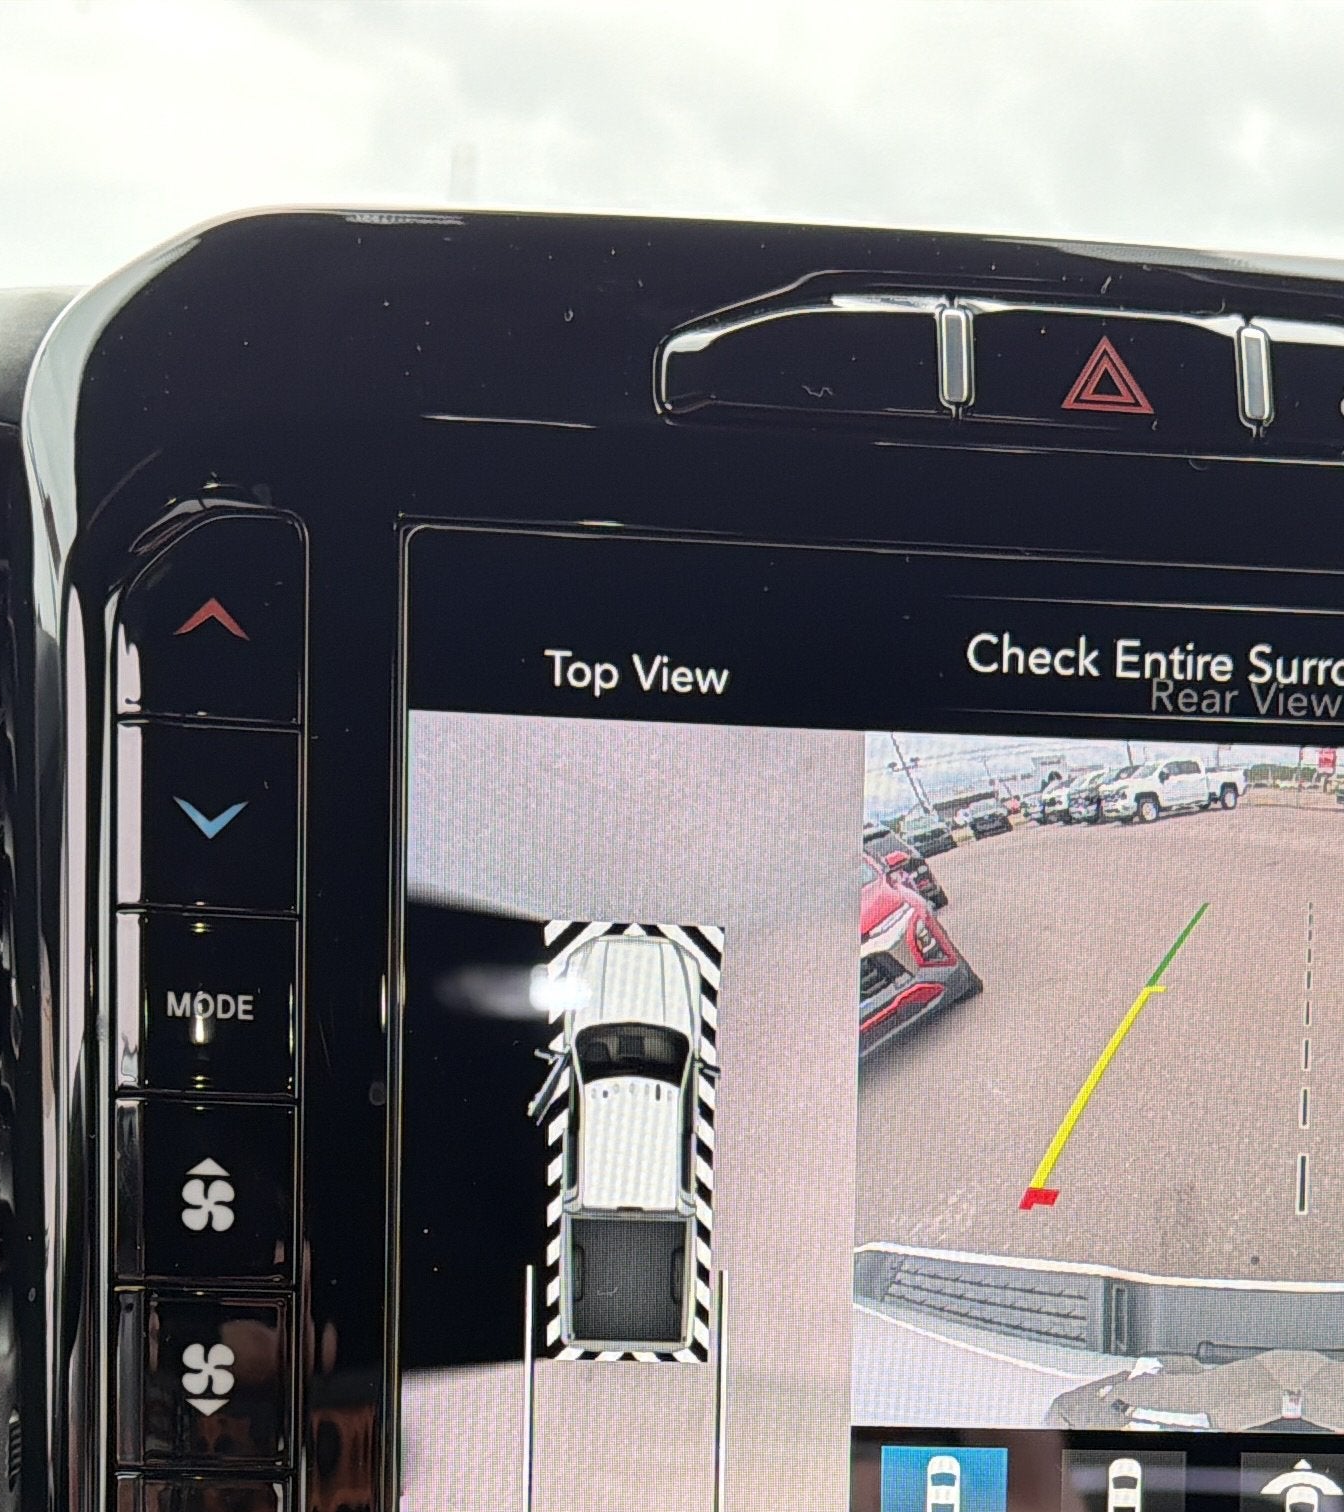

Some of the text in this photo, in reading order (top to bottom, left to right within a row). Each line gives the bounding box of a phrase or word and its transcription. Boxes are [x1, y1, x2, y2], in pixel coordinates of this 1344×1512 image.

[544, 649, 730, 697] Top View
[966, 633, 1100, 678] Check
[1115, 638, 1234, 683] Entire
[1150, 680, 1344, 718] Rear View
[166, 990, 255, 1021] MODE
